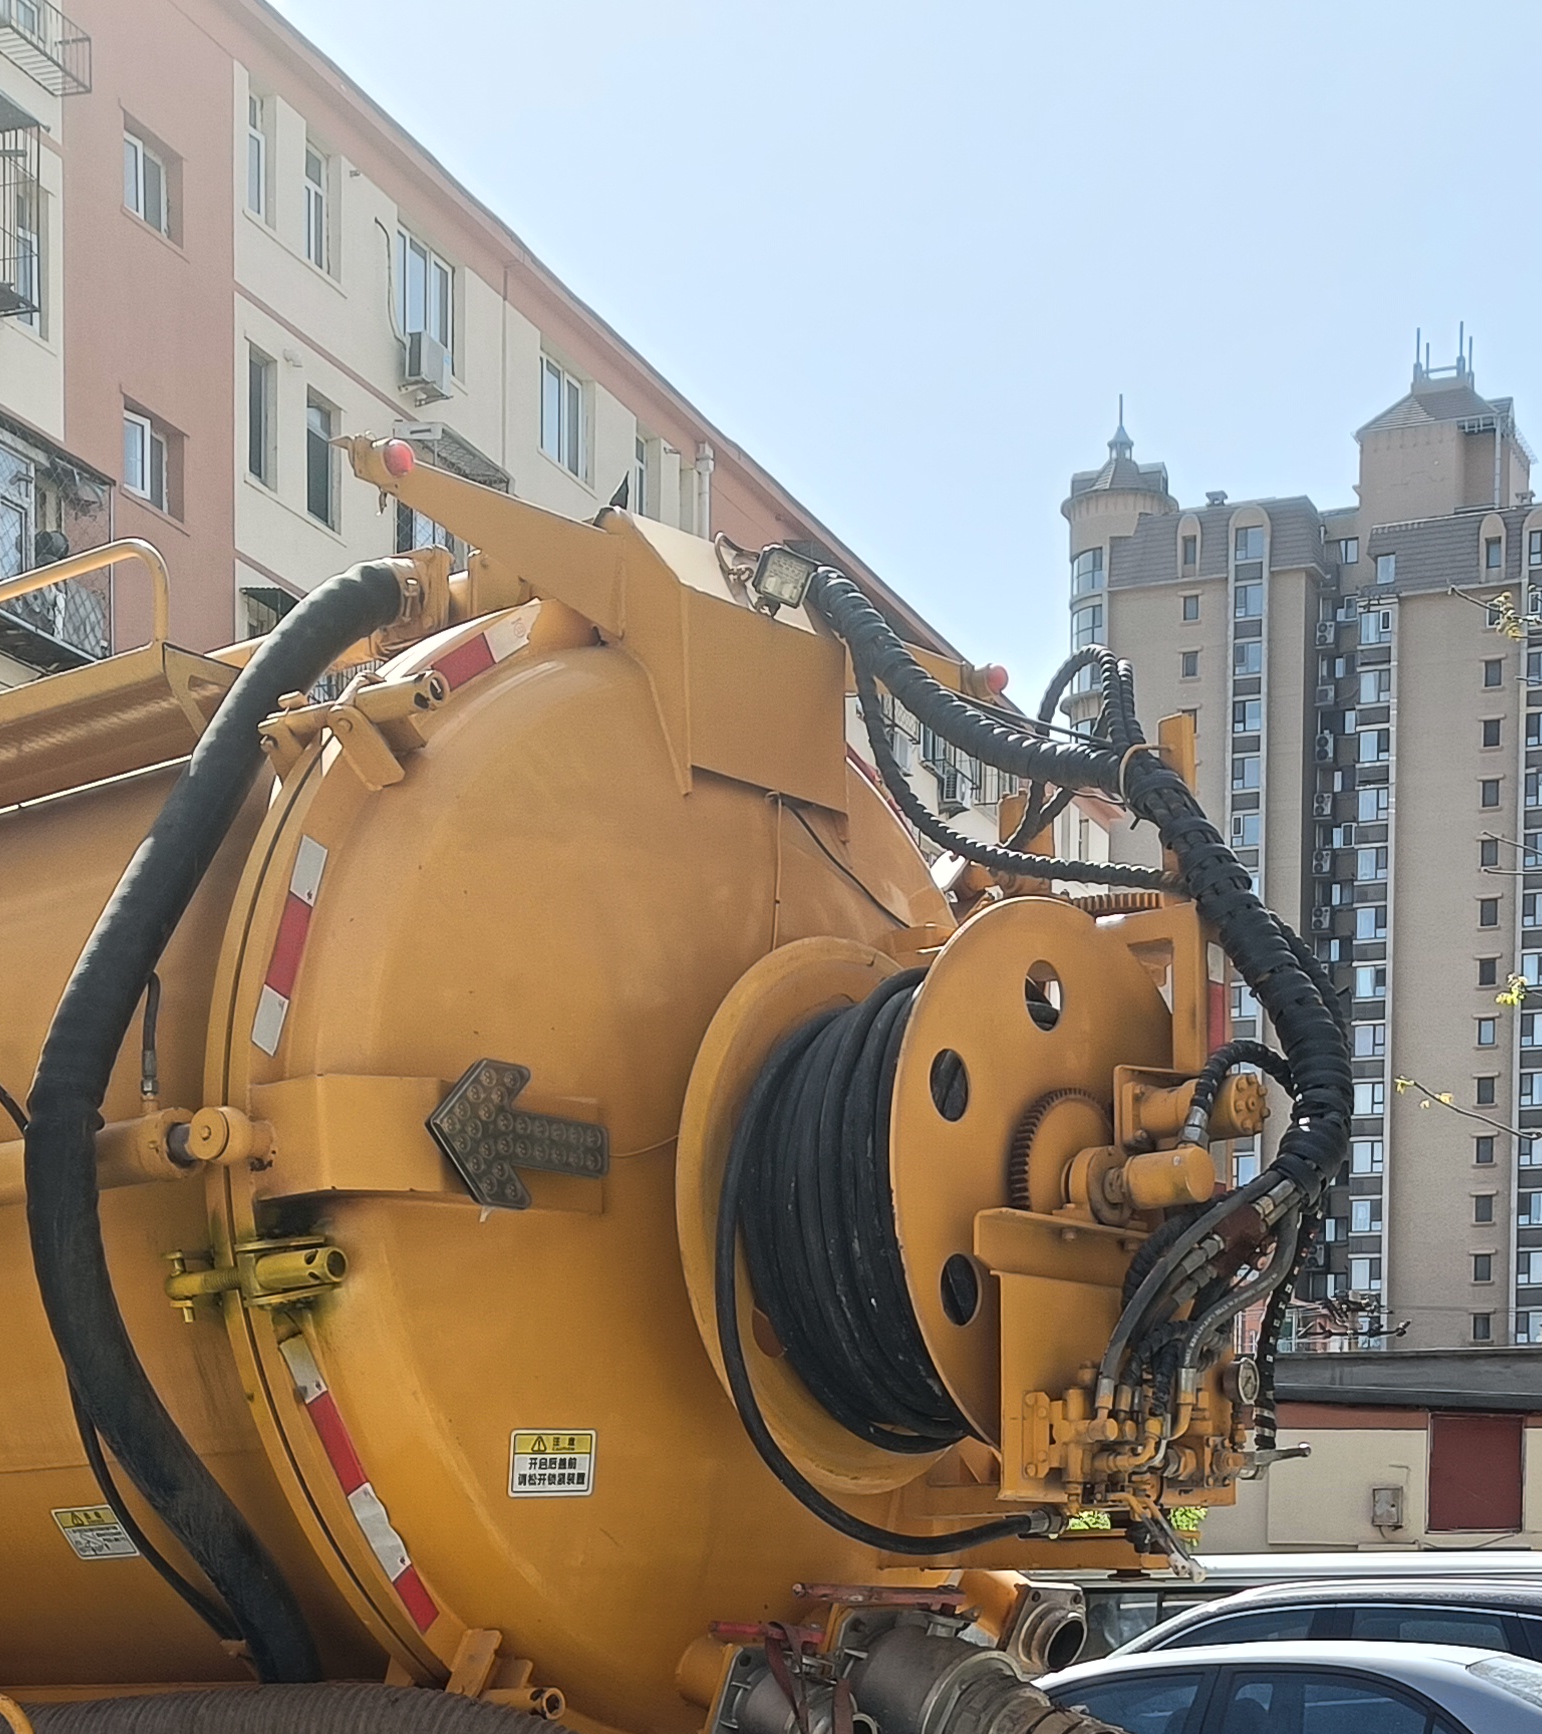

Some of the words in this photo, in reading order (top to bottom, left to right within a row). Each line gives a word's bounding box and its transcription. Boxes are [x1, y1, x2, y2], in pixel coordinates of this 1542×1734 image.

[528, 1456, 577, 1470] 开启后盖前
